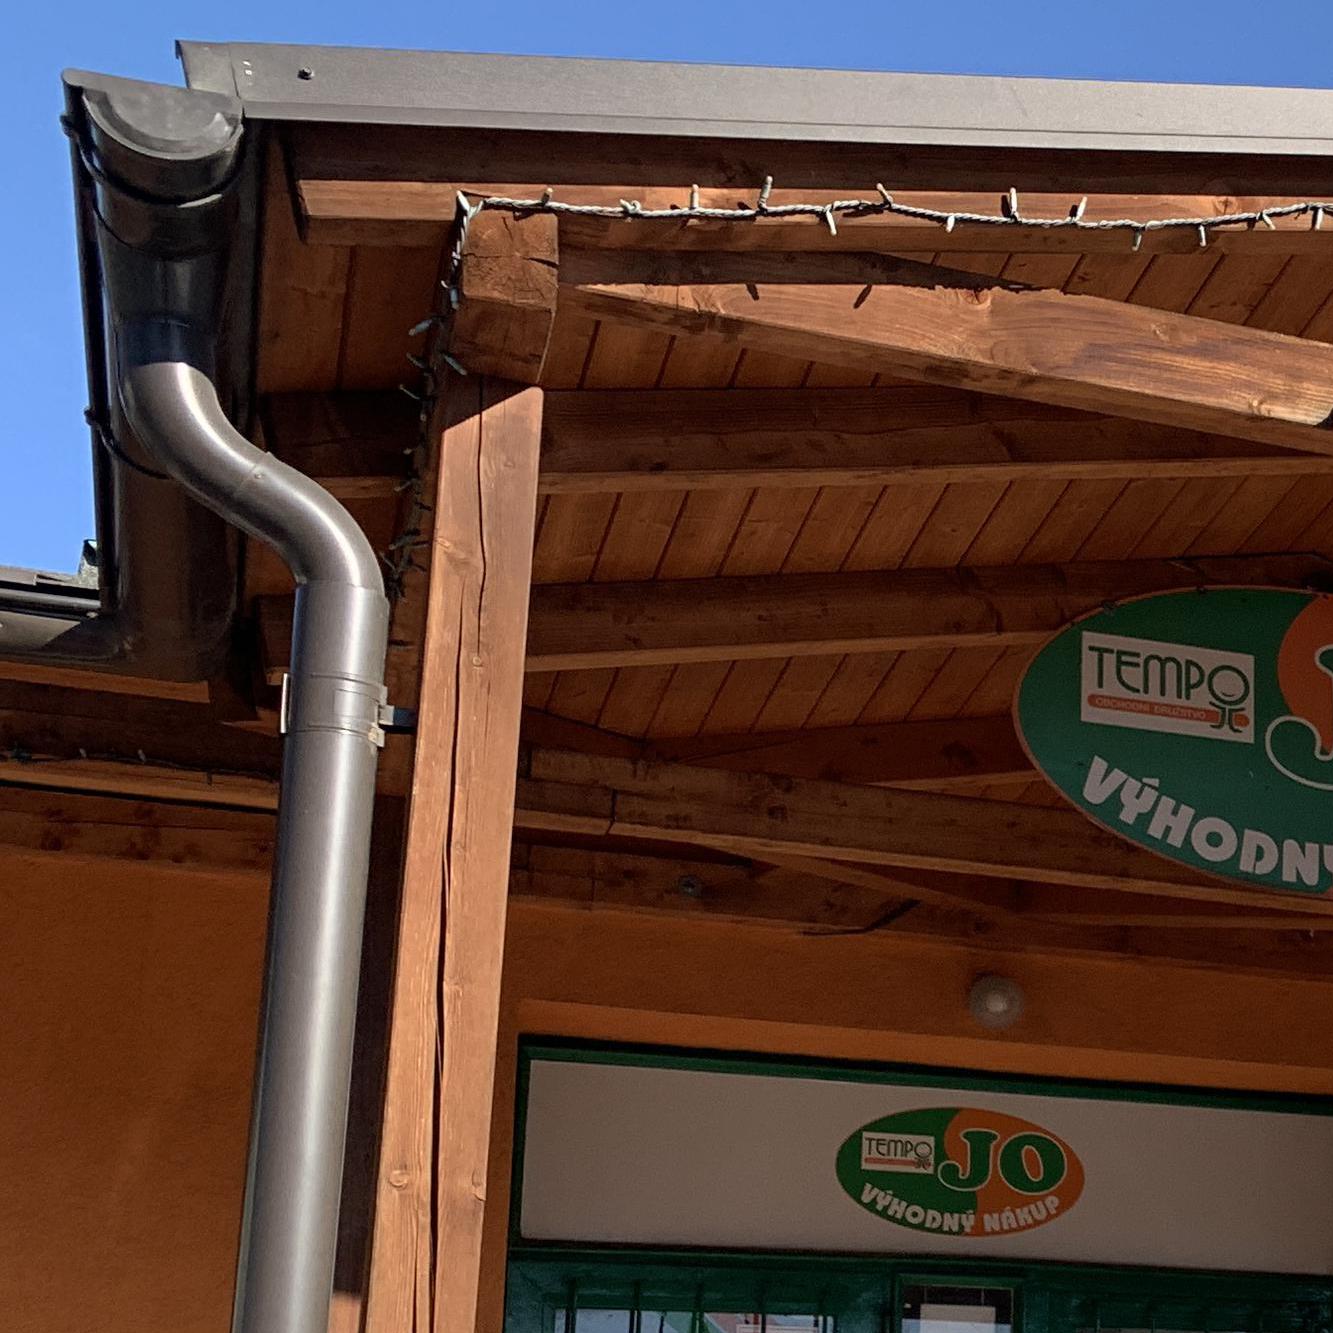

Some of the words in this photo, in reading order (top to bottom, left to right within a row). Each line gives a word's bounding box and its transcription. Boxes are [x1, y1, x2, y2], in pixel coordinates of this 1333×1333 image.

[1088, 646, 1249, 706] TEMPO
[865, 1137, 933, 1160] TEMPO
[938, 1128, 1068, 1195] JO
[860, 1182, 976, 1232] VÝHODNÝ
[984, 1196, 1060, 1231] NÁKUP
